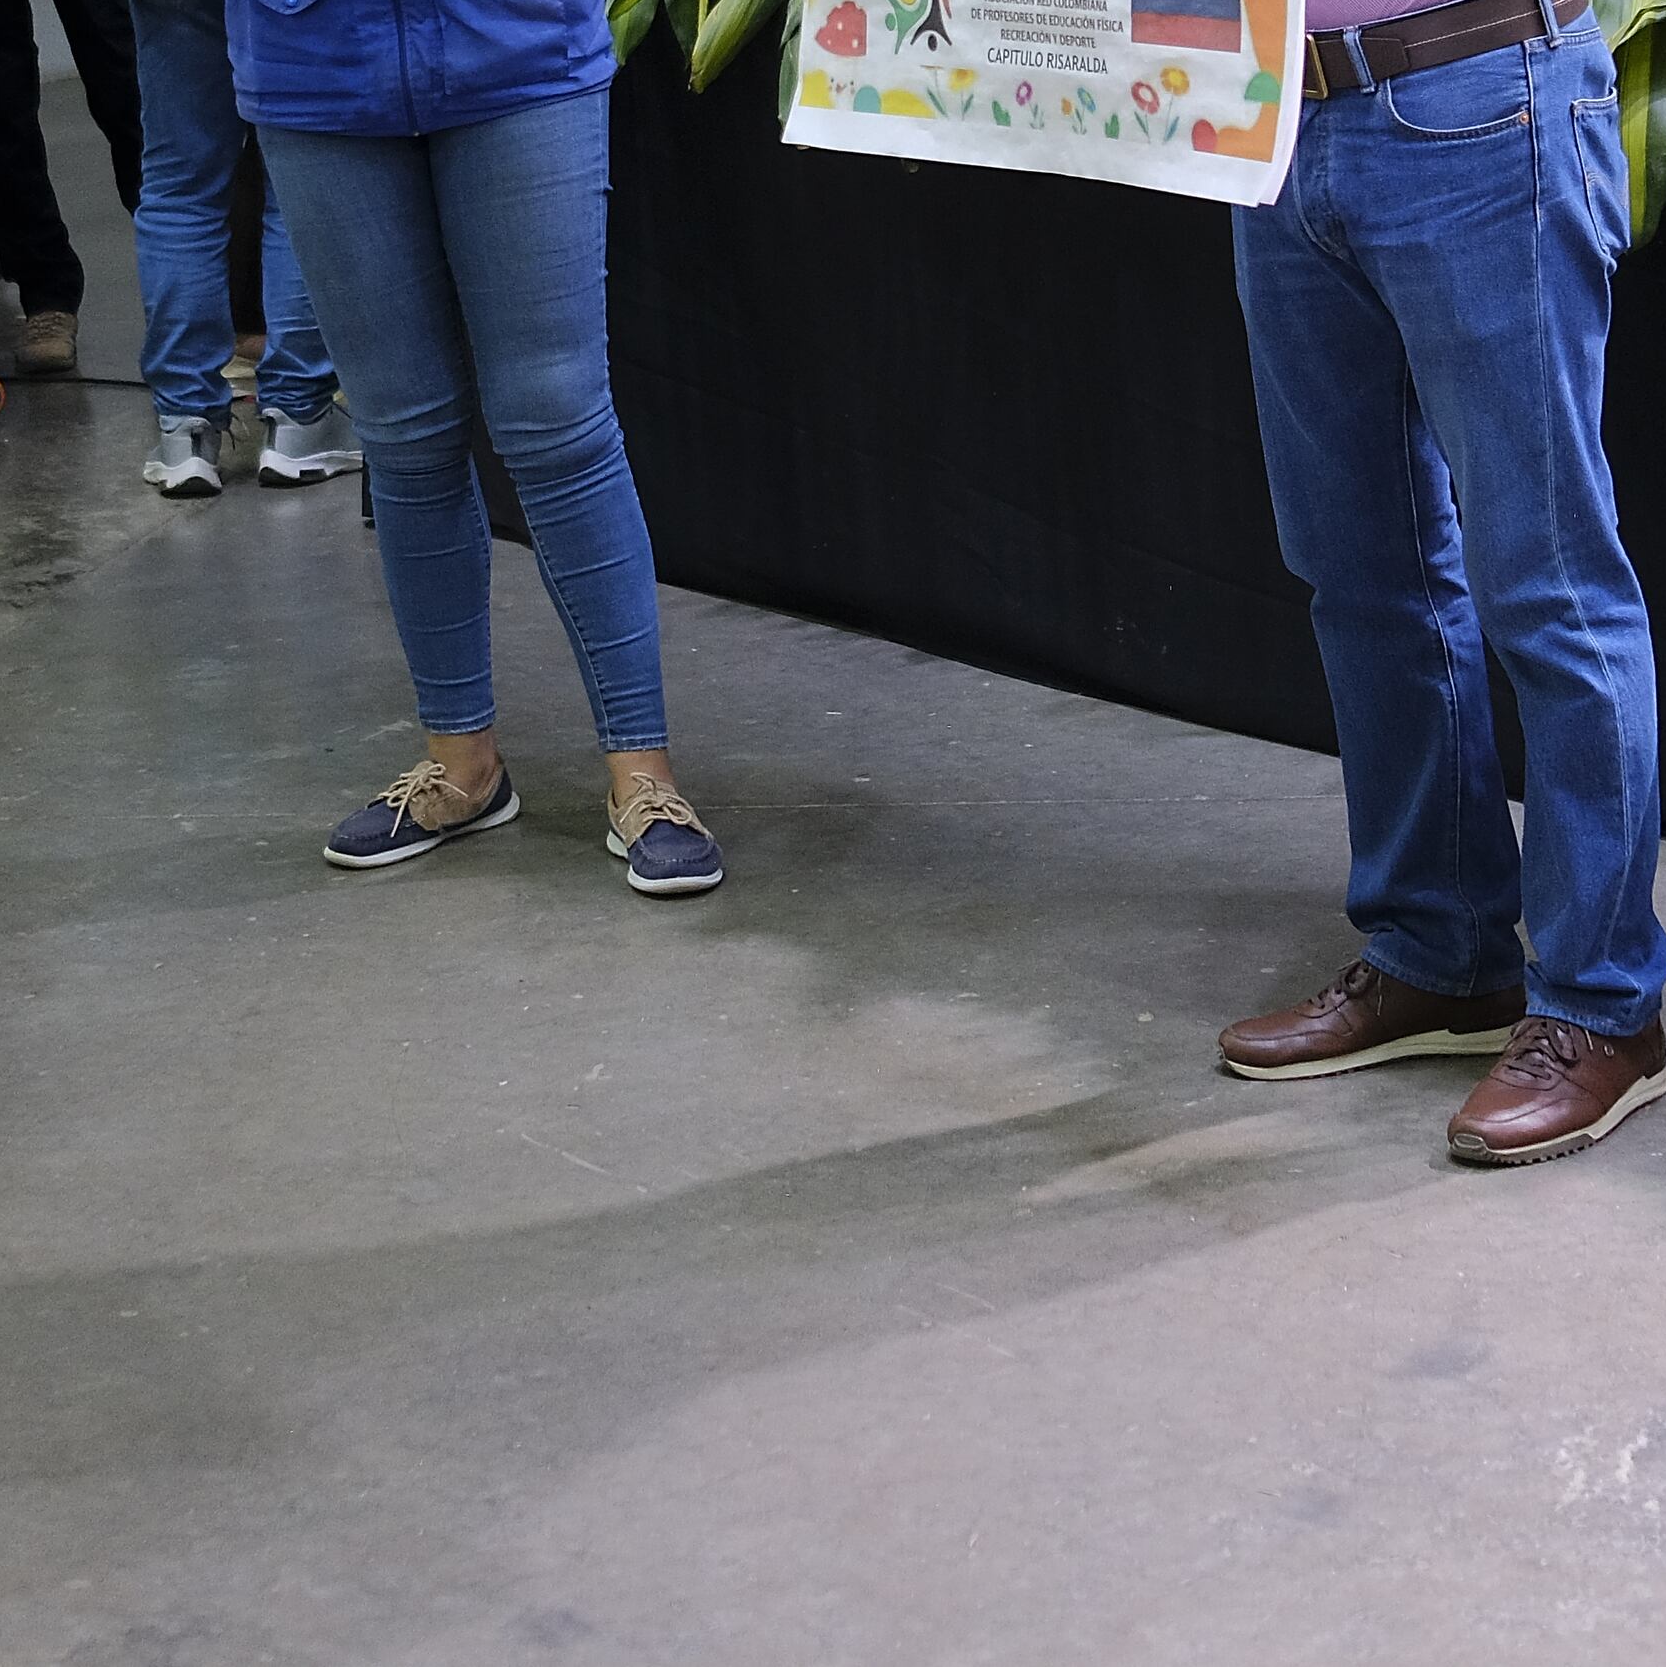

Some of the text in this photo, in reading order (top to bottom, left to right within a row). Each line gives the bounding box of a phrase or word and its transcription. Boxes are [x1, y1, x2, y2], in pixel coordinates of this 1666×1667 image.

[971, 8, 1124, 33] DE PROFESORES DE EDUCACIÓN FÍSICA
[1000, 29, 1097, 49] RECREACIÓN Y DEPORTE
[987, 47, 1108, 74] CAPITULO RISARALDA
